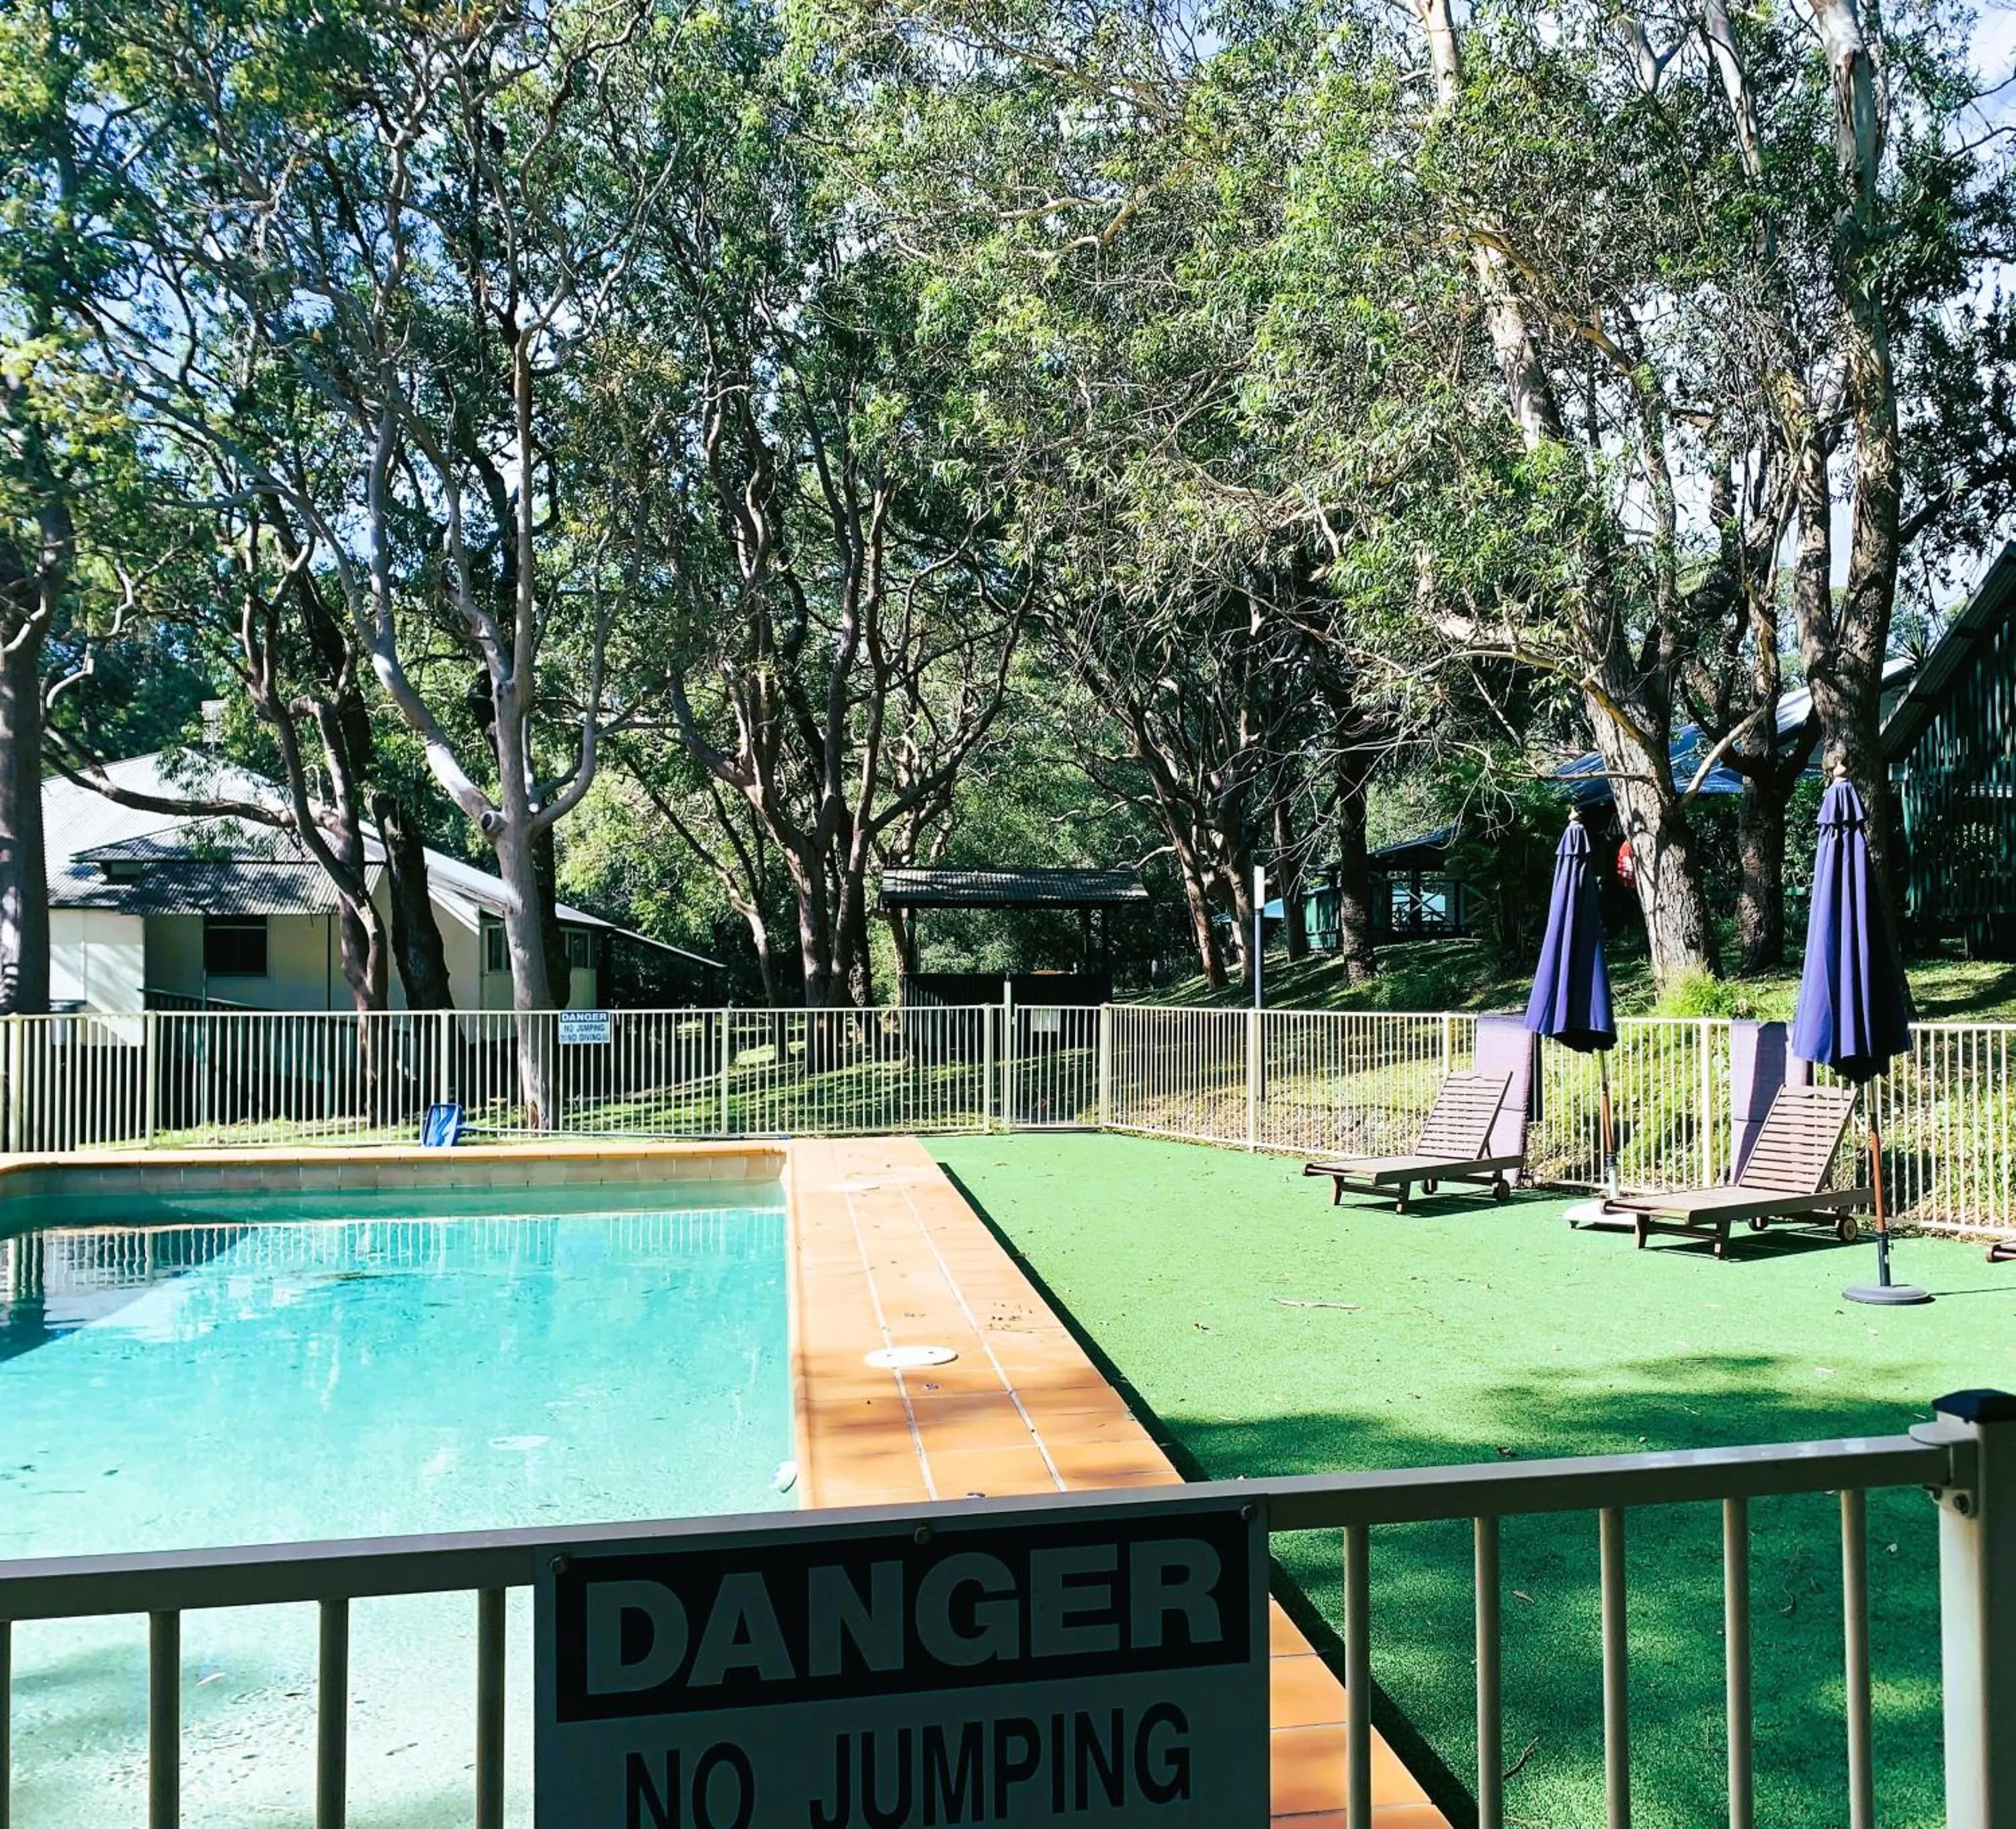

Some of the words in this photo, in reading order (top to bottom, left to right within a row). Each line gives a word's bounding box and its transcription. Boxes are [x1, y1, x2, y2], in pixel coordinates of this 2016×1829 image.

[562, 1013, 607, 1021] DANGER
[587, 1537, 1223, 1695] DANGER
[625, 1742, 755, 1829] NO
[809, 1702, 1191, 1829] JUMPING
